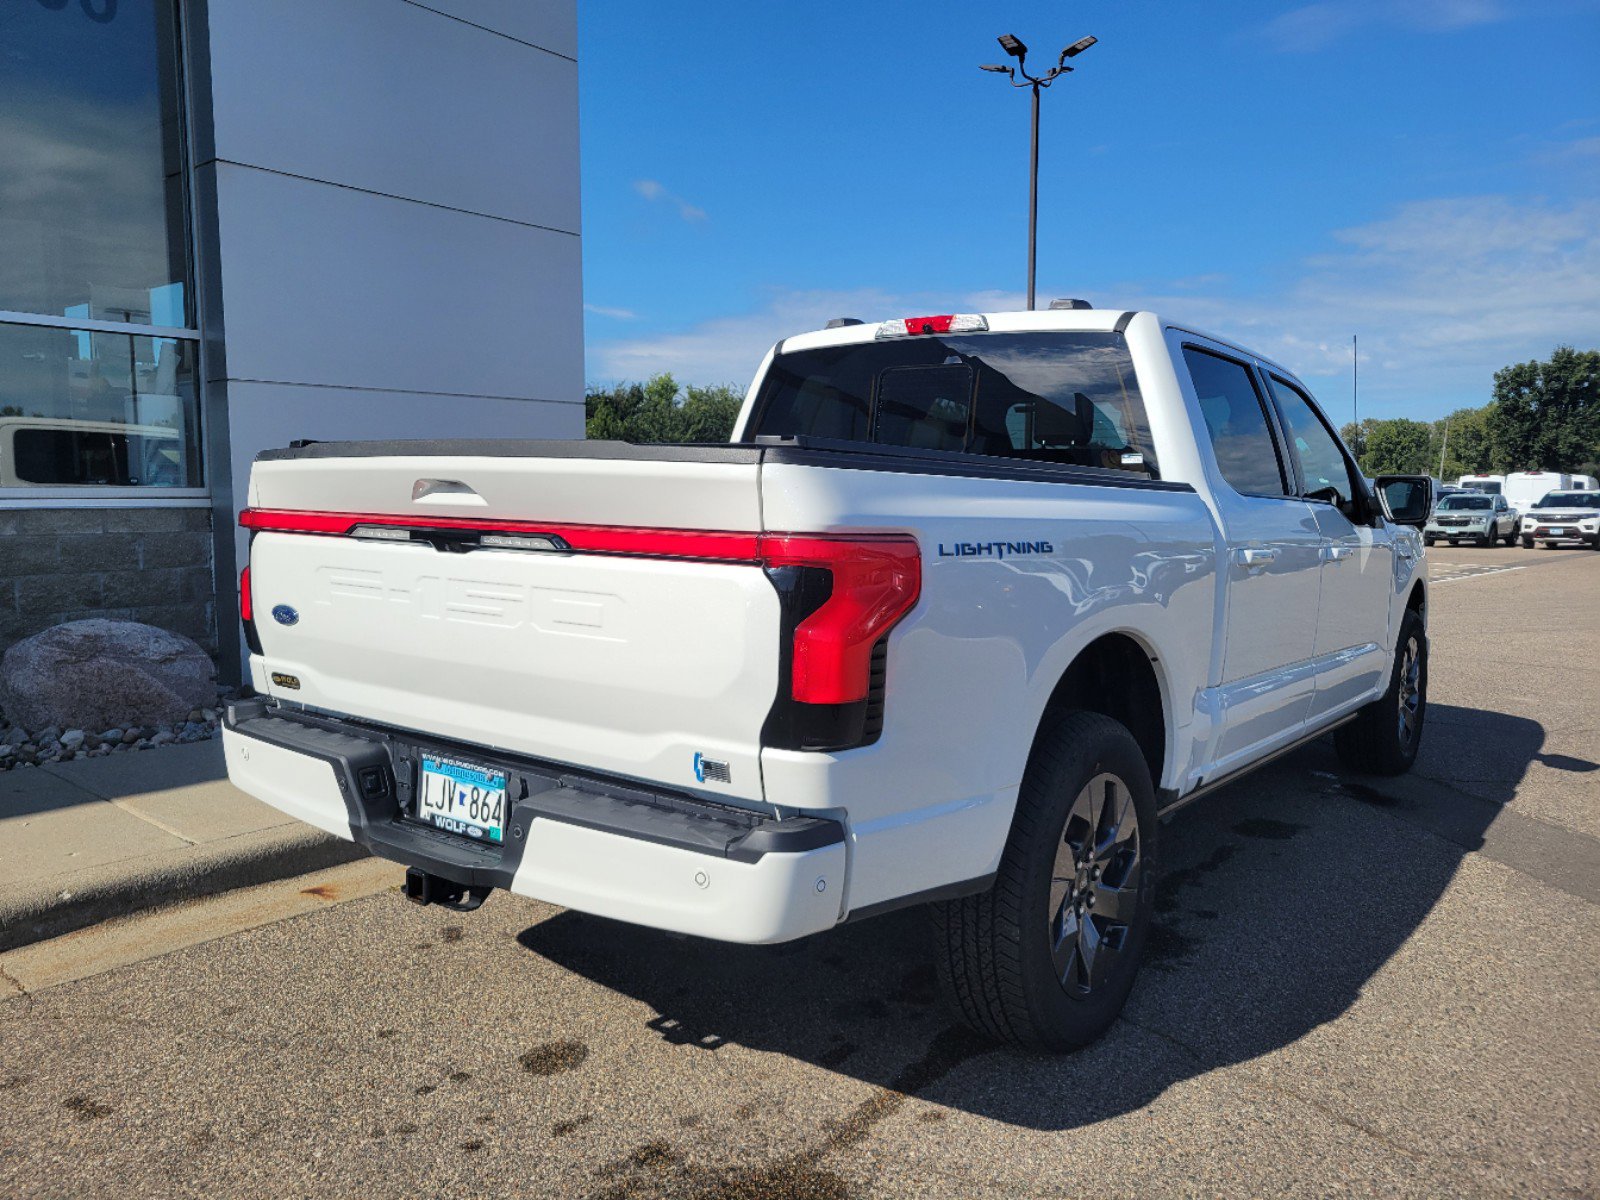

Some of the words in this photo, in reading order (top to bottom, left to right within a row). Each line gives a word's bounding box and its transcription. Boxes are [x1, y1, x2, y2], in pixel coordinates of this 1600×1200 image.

[938, 541, 1054, 560] LIGHTNING
[424, 773, 457, 813] LJV
[469, 786, 503, 828] 864
[434, 814, 467, 834] WOLF
